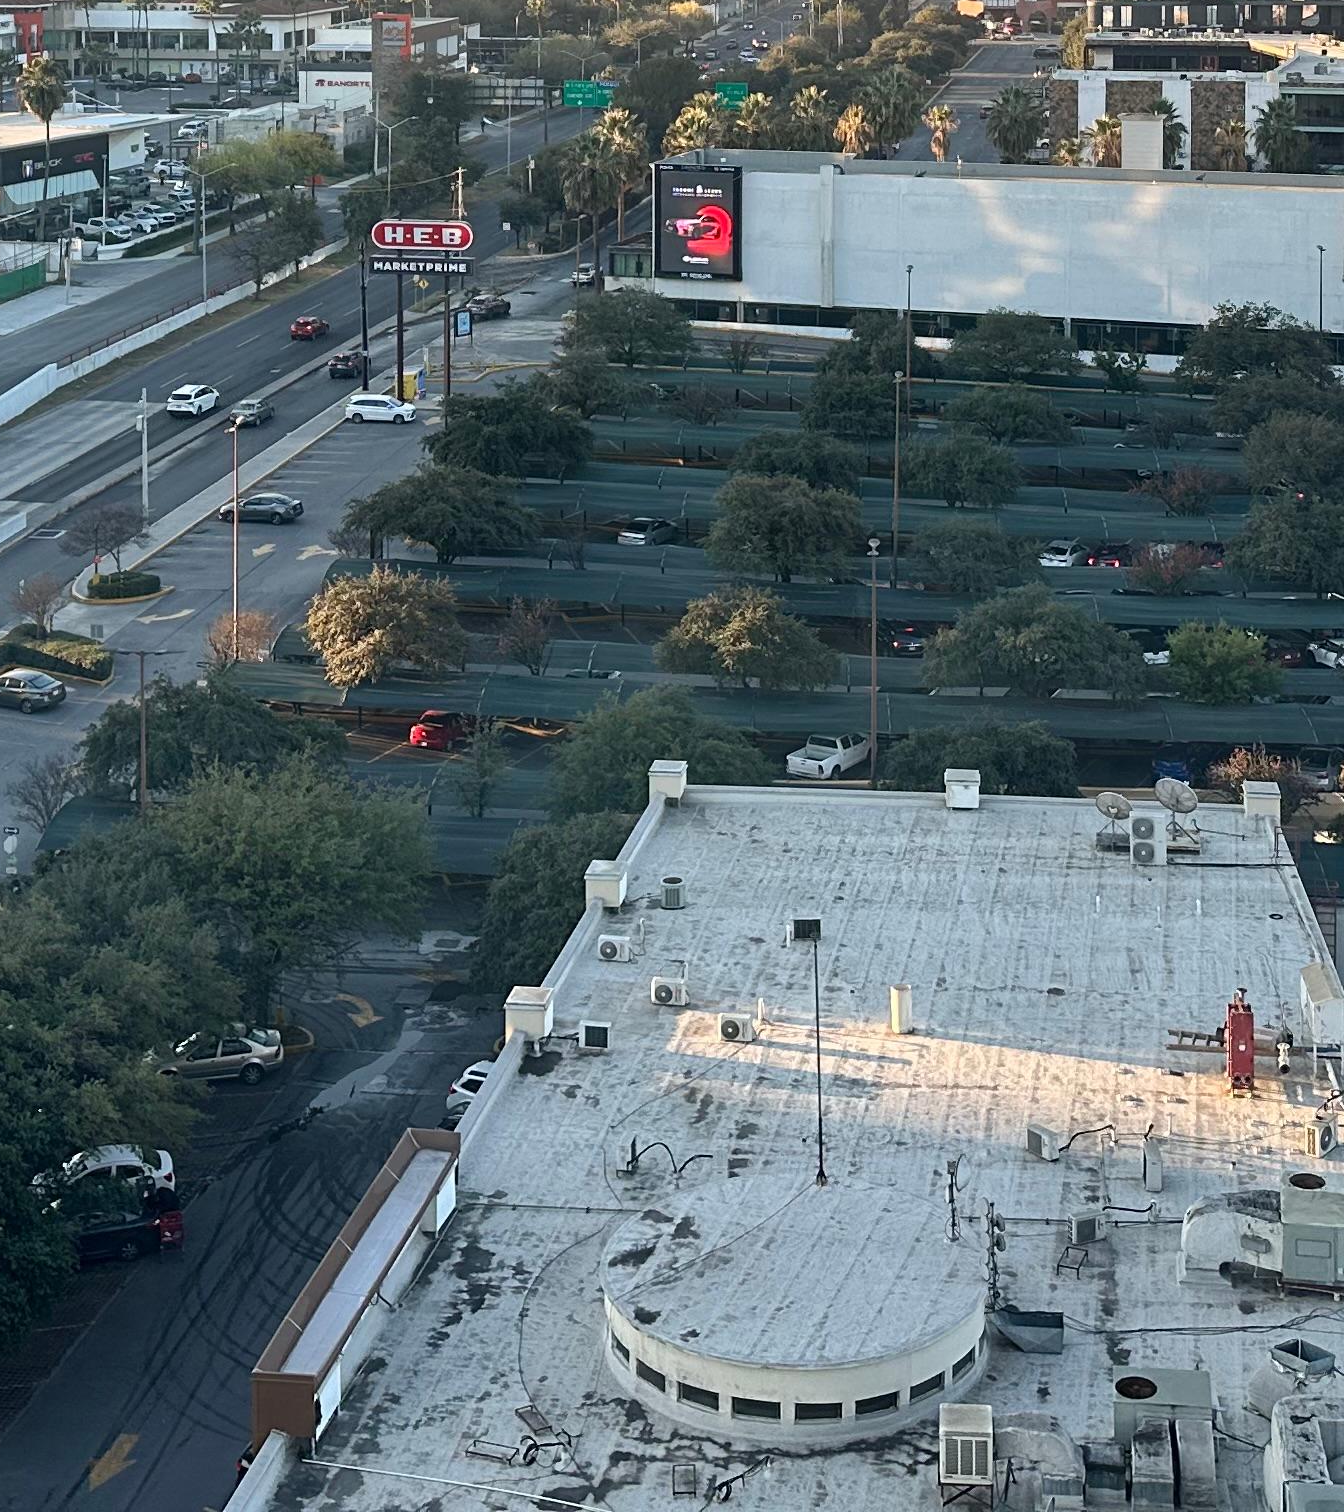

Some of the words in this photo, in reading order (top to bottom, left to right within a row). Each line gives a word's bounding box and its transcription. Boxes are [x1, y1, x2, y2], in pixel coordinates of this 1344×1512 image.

[327, 79, 371, 88] BANORTE
[34, 157, 63, 170] BUCK
[373, 261, 467, 273] MARKETPRIME
